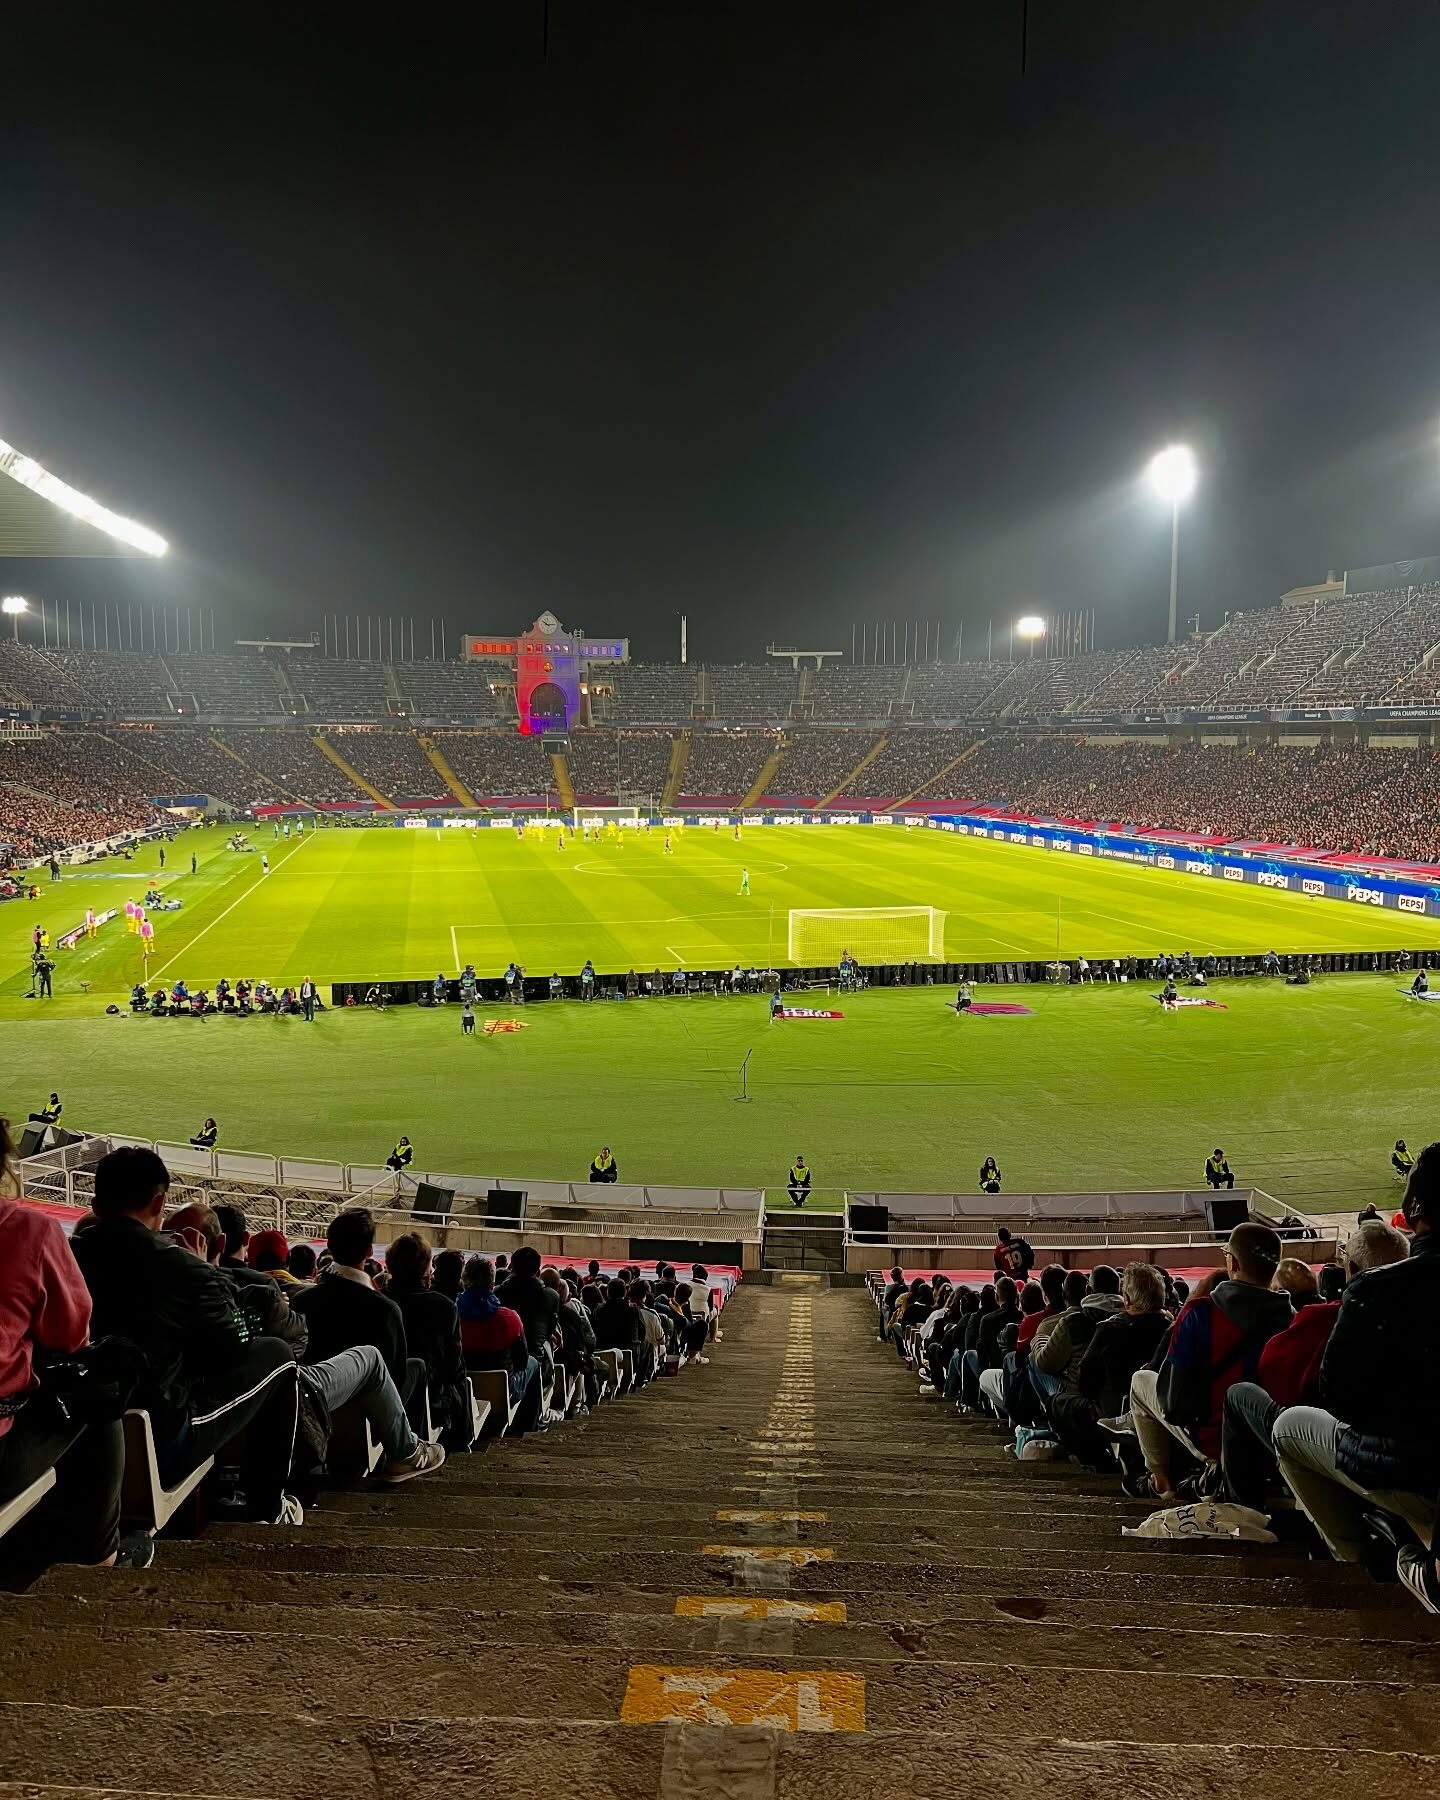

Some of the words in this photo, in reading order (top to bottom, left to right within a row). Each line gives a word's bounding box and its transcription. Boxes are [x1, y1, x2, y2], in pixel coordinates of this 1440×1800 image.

[1053, 839, 1071, 852] PEPSI
[1080, 844, 1092, 854] PEPSI
[1159, 857, 1173, 868] PEPSI
[1186, 860, 1212, 876] PEPSI
[1225, 868, 1242, 879] PEPSI
[1258, 872, 1288, 888] PEPSI
[1304, 881, 1323, 893] PEPSI
[1348, 886, 1384, 905] PEPSI
[1400, 898, 1424, 910] PEPSI
[1005, 1250, 1022, 1270] 19
